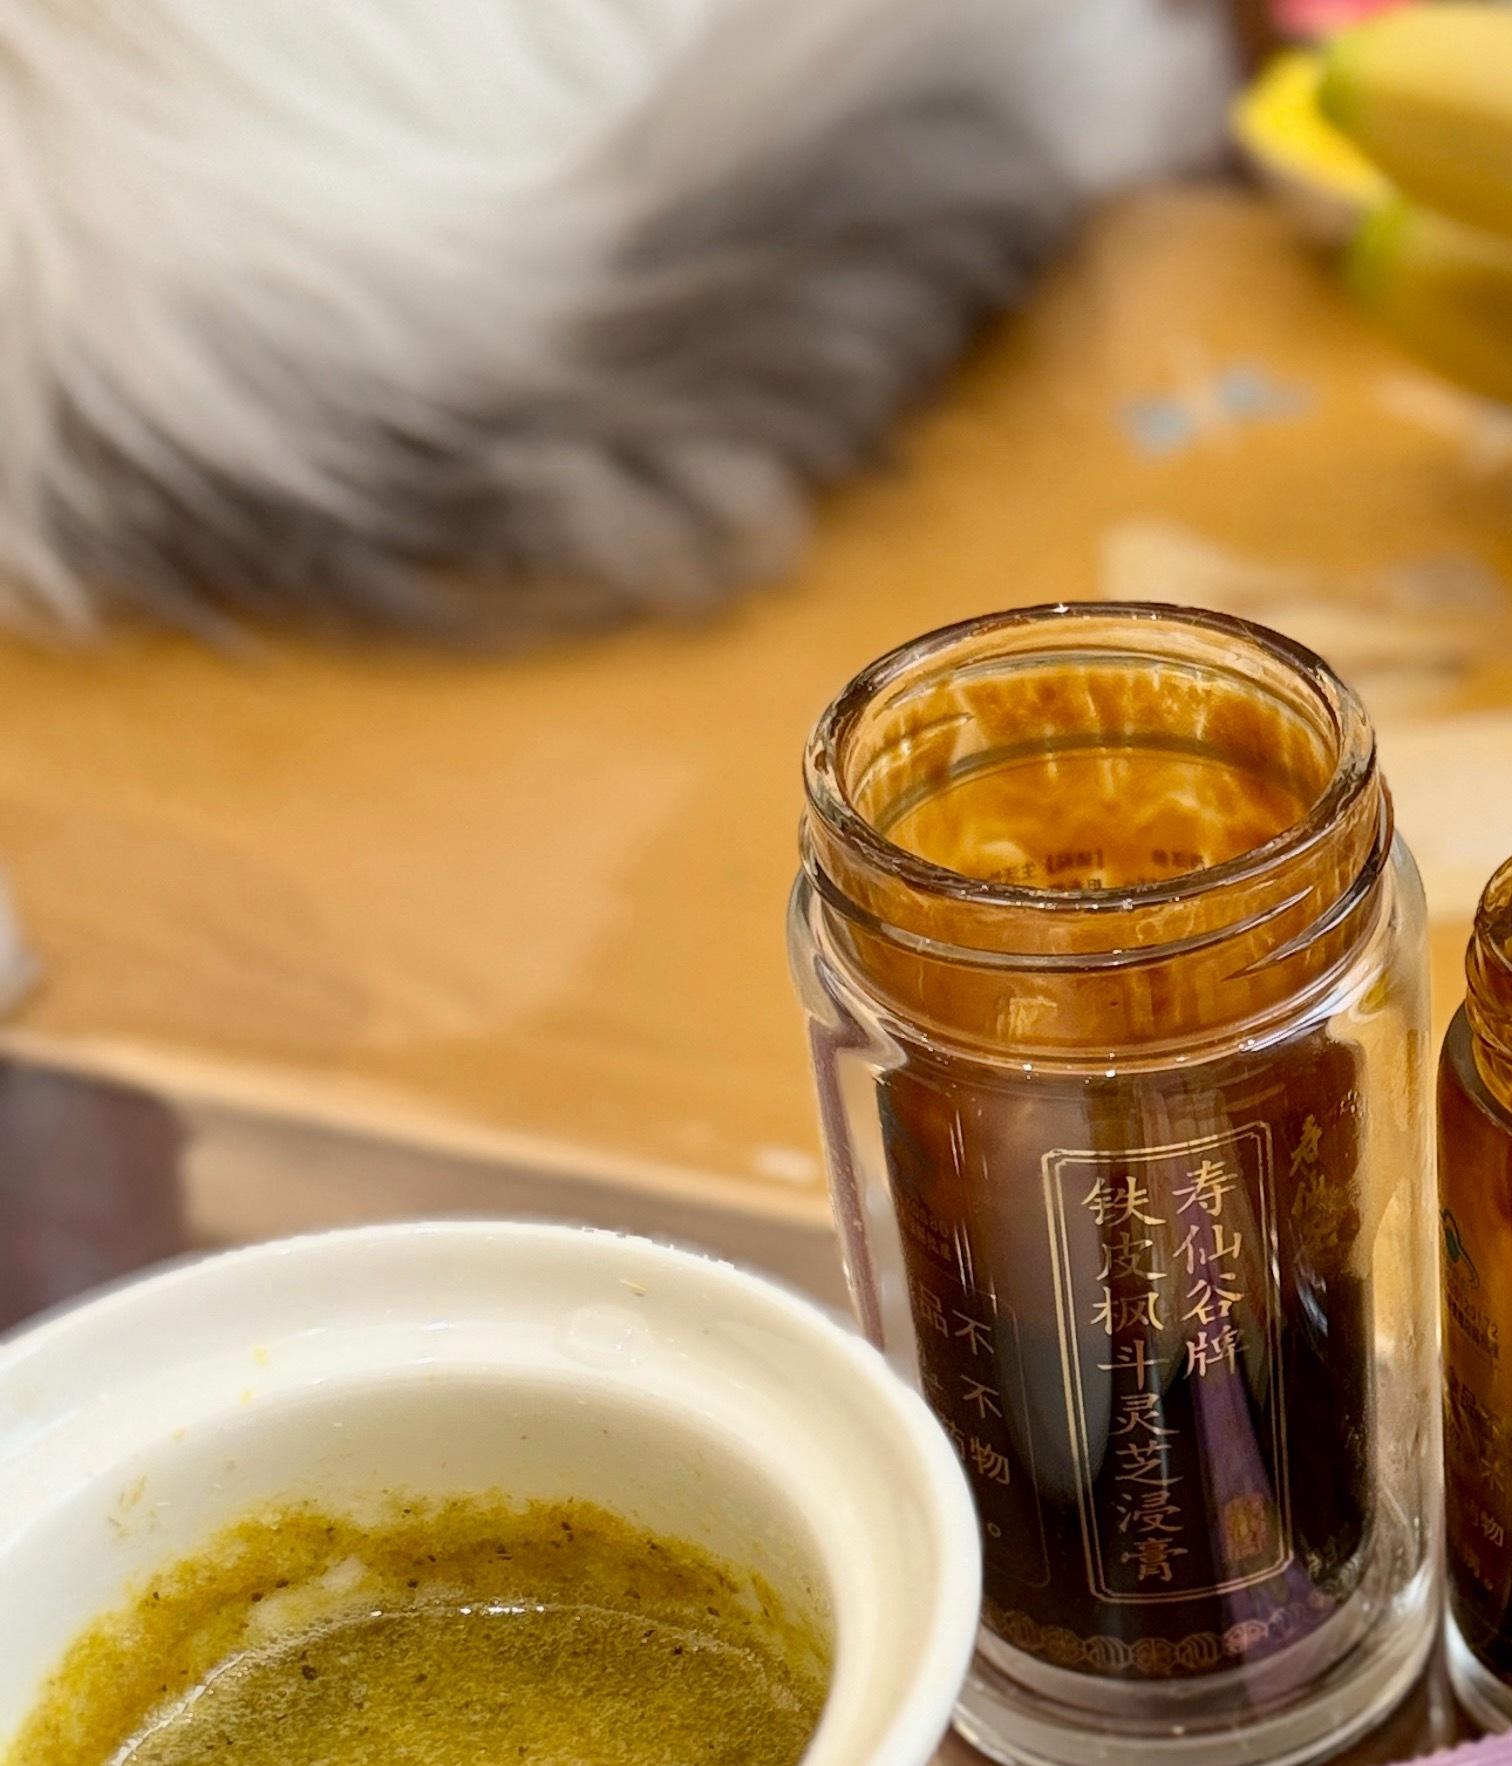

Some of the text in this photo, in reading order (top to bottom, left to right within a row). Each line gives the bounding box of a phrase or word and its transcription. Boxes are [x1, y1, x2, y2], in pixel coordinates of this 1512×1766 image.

[1080, 1175, 1190, 1582] 铁皮枫斗灵芝浸膏
[1172, 1158, 1251, 1380] 寿仙谷牌
